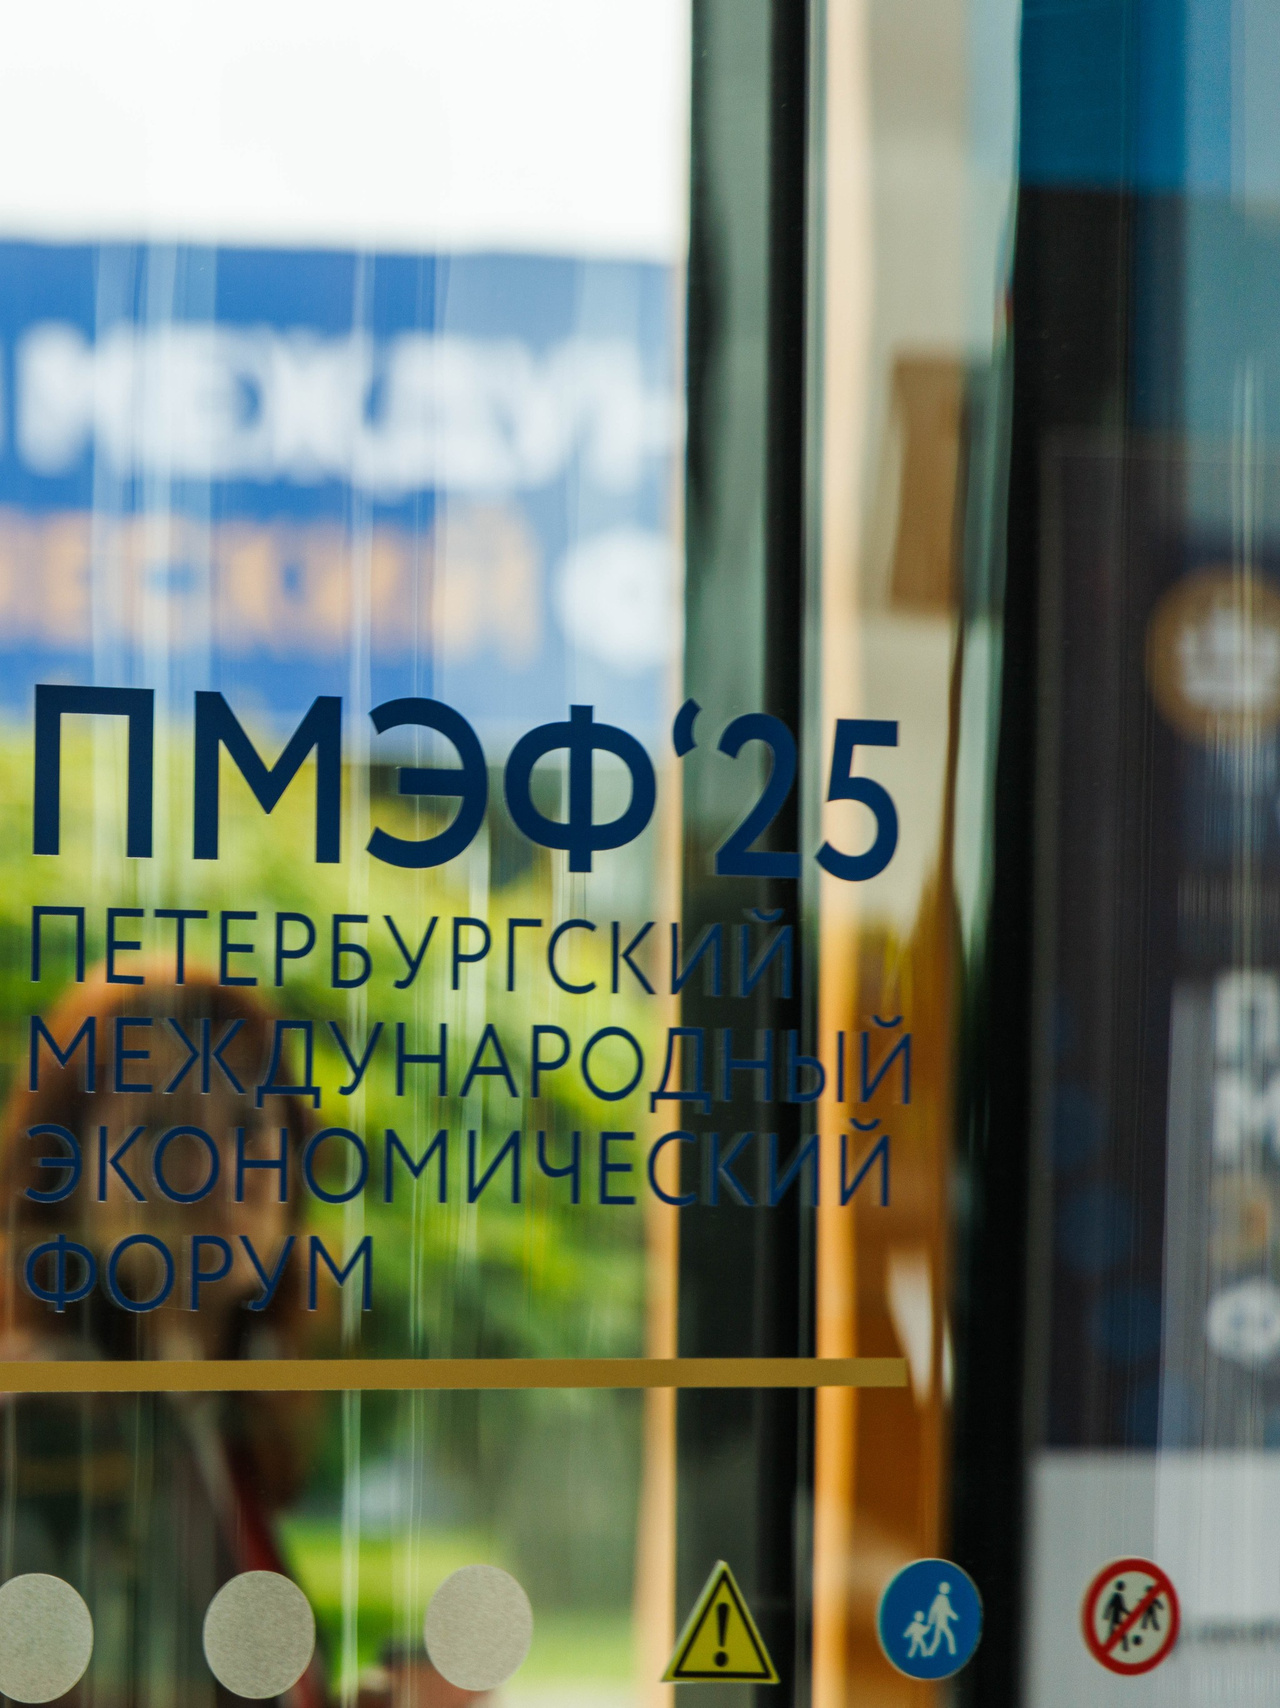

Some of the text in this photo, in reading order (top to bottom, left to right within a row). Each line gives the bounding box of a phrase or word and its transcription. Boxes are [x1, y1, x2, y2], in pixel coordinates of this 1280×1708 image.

[29, 905, 794, 999] ПЕТЕРБУРГСКИЙ
[27, 1015, 914, 1114] МЕЖДУНАРОДНЫЙ
[23, 1118, 892, 1206] ЭКОНОМИЧЕСКИЙ
[24, 1232, 374, 1312] ФОРУМ
